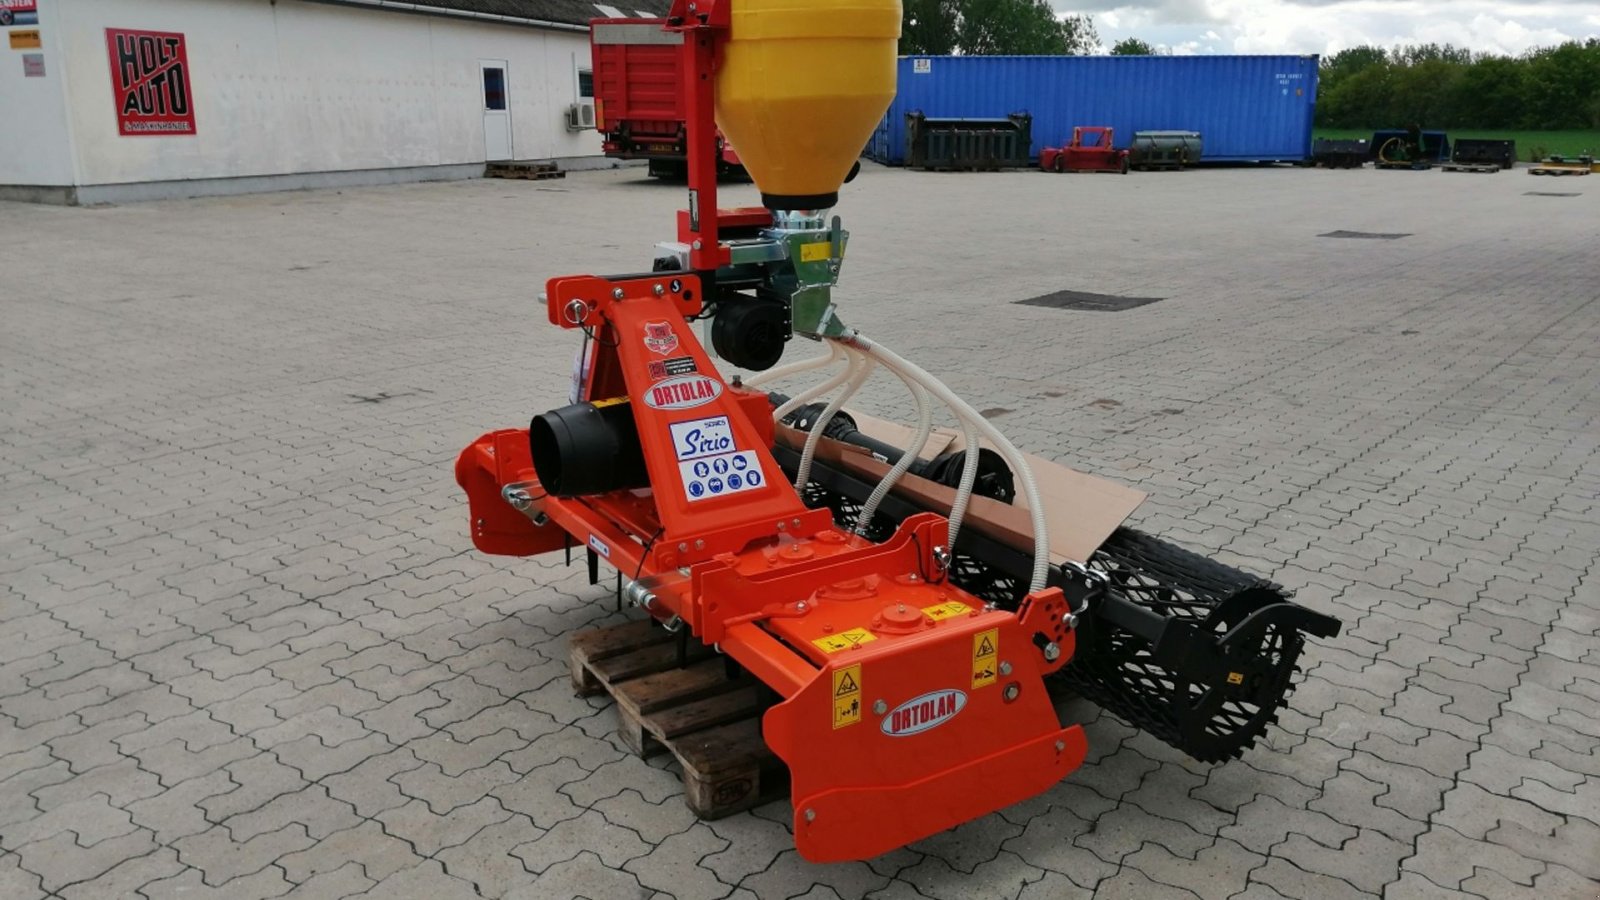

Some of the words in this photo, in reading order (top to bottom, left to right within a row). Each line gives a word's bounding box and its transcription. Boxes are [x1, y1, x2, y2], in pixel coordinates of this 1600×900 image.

[116, 34, 179, 90] HOLT
[122, 62, 188, 116] AUTO
[132, 121, 191, 131] MASKINHANDEL
[652, 379, 715, 407] ORTOLAN
[681, 428, 730, 456] Sirio
[891, 692, 956, 734] ORTOLAN
